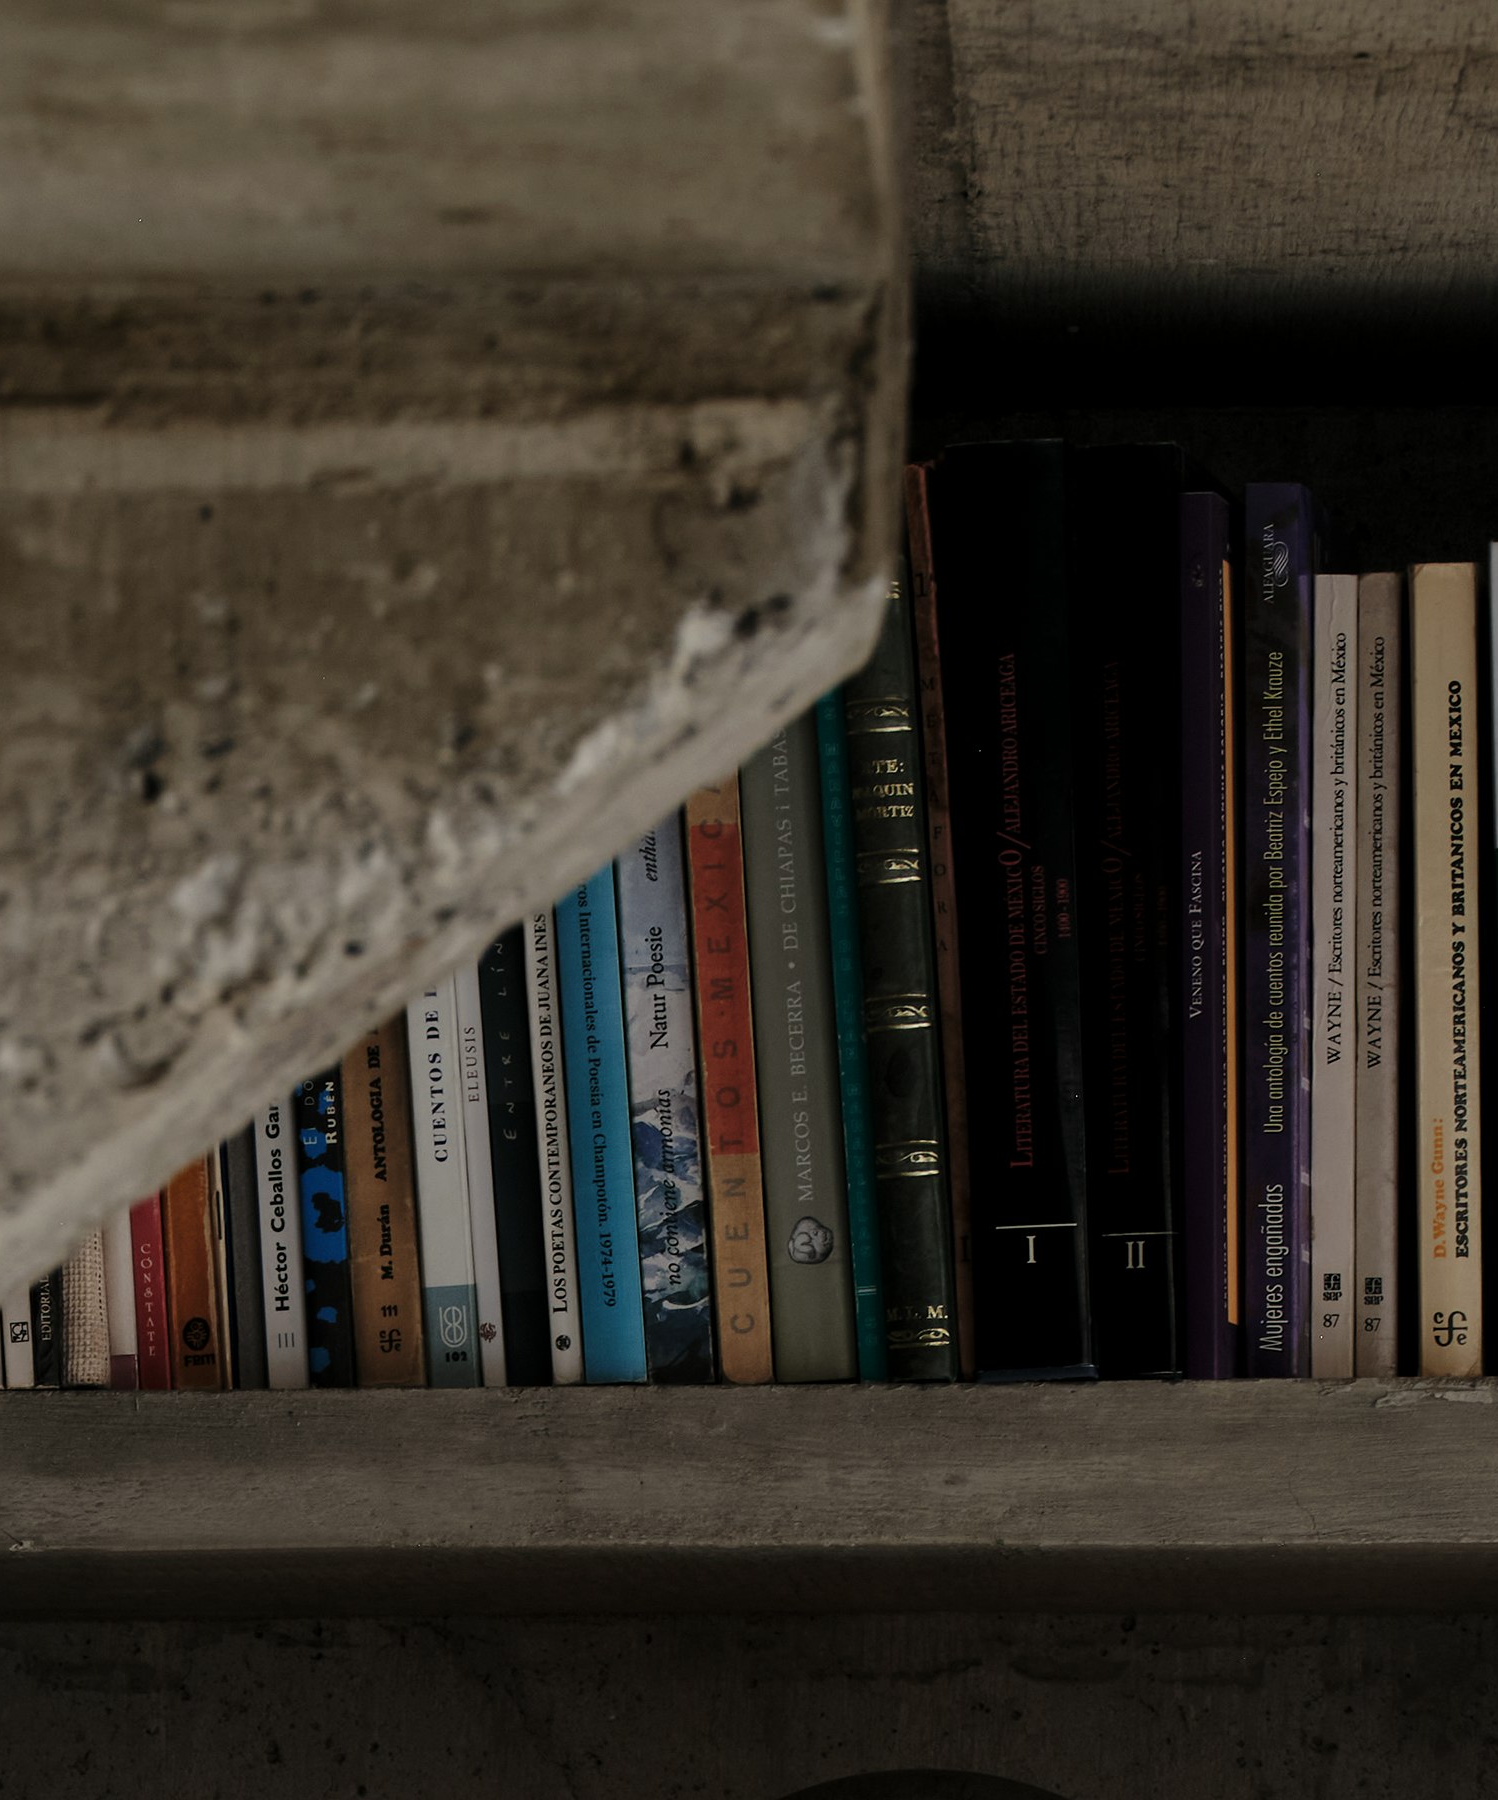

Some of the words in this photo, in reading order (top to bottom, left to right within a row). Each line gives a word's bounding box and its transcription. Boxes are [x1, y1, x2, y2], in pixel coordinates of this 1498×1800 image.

[1263, 651, 1283, 700] Krauze
[1263, 706, 1283, 740] Ethel
[1263, 759, 1288, 805] Espejo
[1264, 812, 1283, 860] Beatriz
[1268, 866, 1288, 888] por
[1265, 895, 1284, 946] reunida
[1265, 952, 1283, 1006] cuentos
[1263, 1012, 1283, 1028] de
[1263, 1034, 1288, 1100] antología
[1264, 1106, 1283, 1133] Una
[268, 1149, 285, 1233] Ceballos
[1258, 1184, 1287, 1277] engañadas
[274, 1242, 290, 1311] Héctor
[1259, 1284, 1288, 1352] Mujeres
